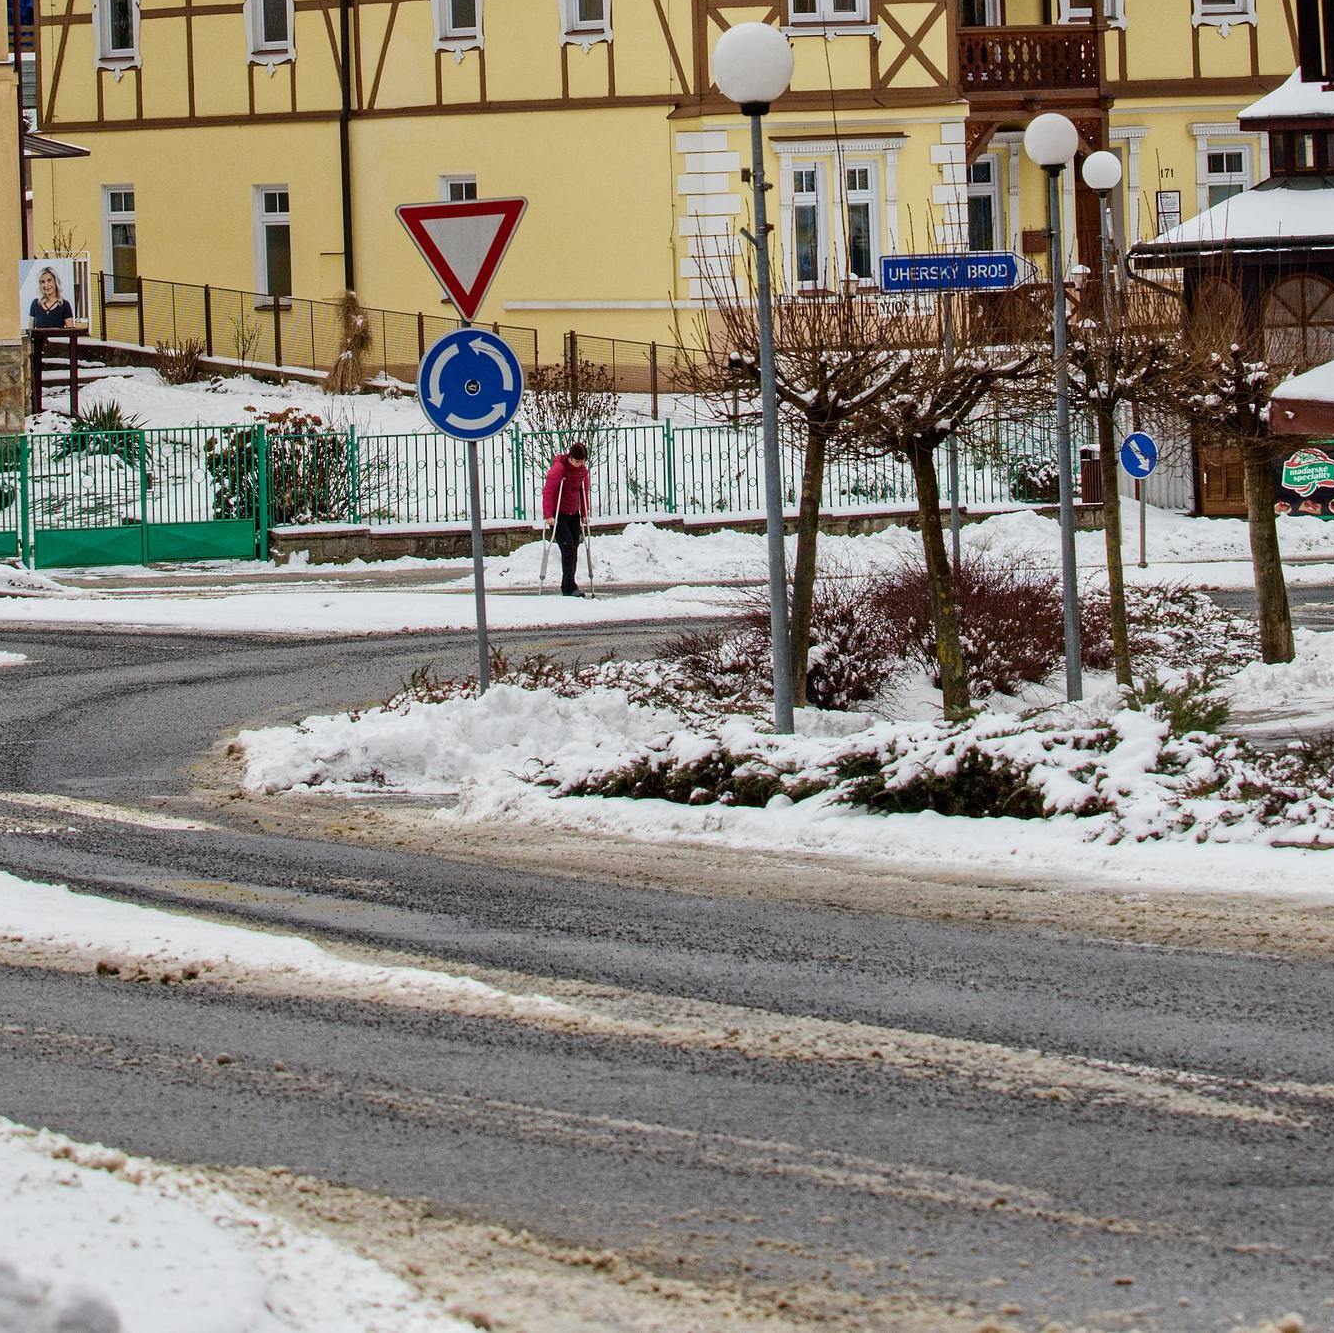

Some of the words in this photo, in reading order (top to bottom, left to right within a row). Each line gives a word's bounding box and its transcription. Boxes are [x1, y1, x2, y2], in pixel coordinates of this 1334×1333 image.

[1160, 168, 1174, 178] 171
[888, 264, 959, 281] UHERSKÝ
[967, 264, 1008, 279] BROD
[1293, 472, 1330, 482] speciality
